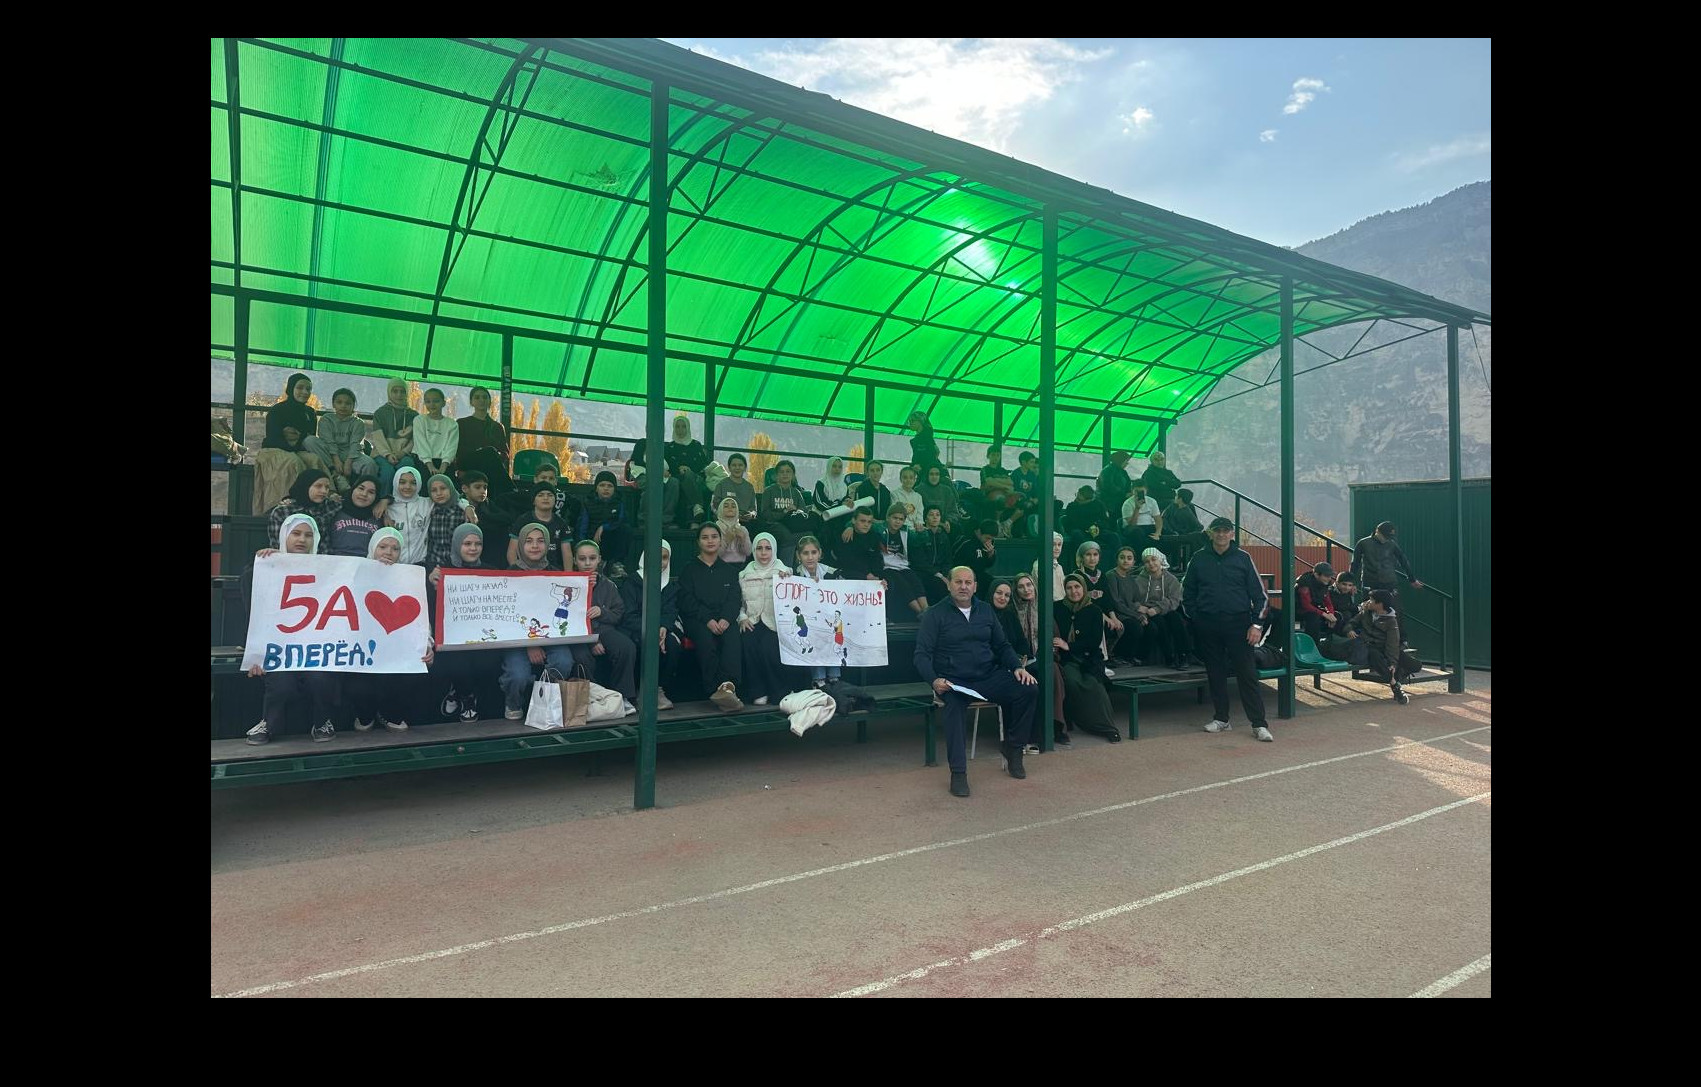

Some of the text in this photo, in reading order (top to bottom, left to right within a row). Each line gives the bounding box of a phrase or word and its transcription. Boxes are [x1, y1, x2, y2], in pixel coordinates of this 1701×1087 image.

[276, 575, 360, 634] 5А
[776, 582, 882, 606] СПОРТ ЭТО ЖИЗНЬ!
